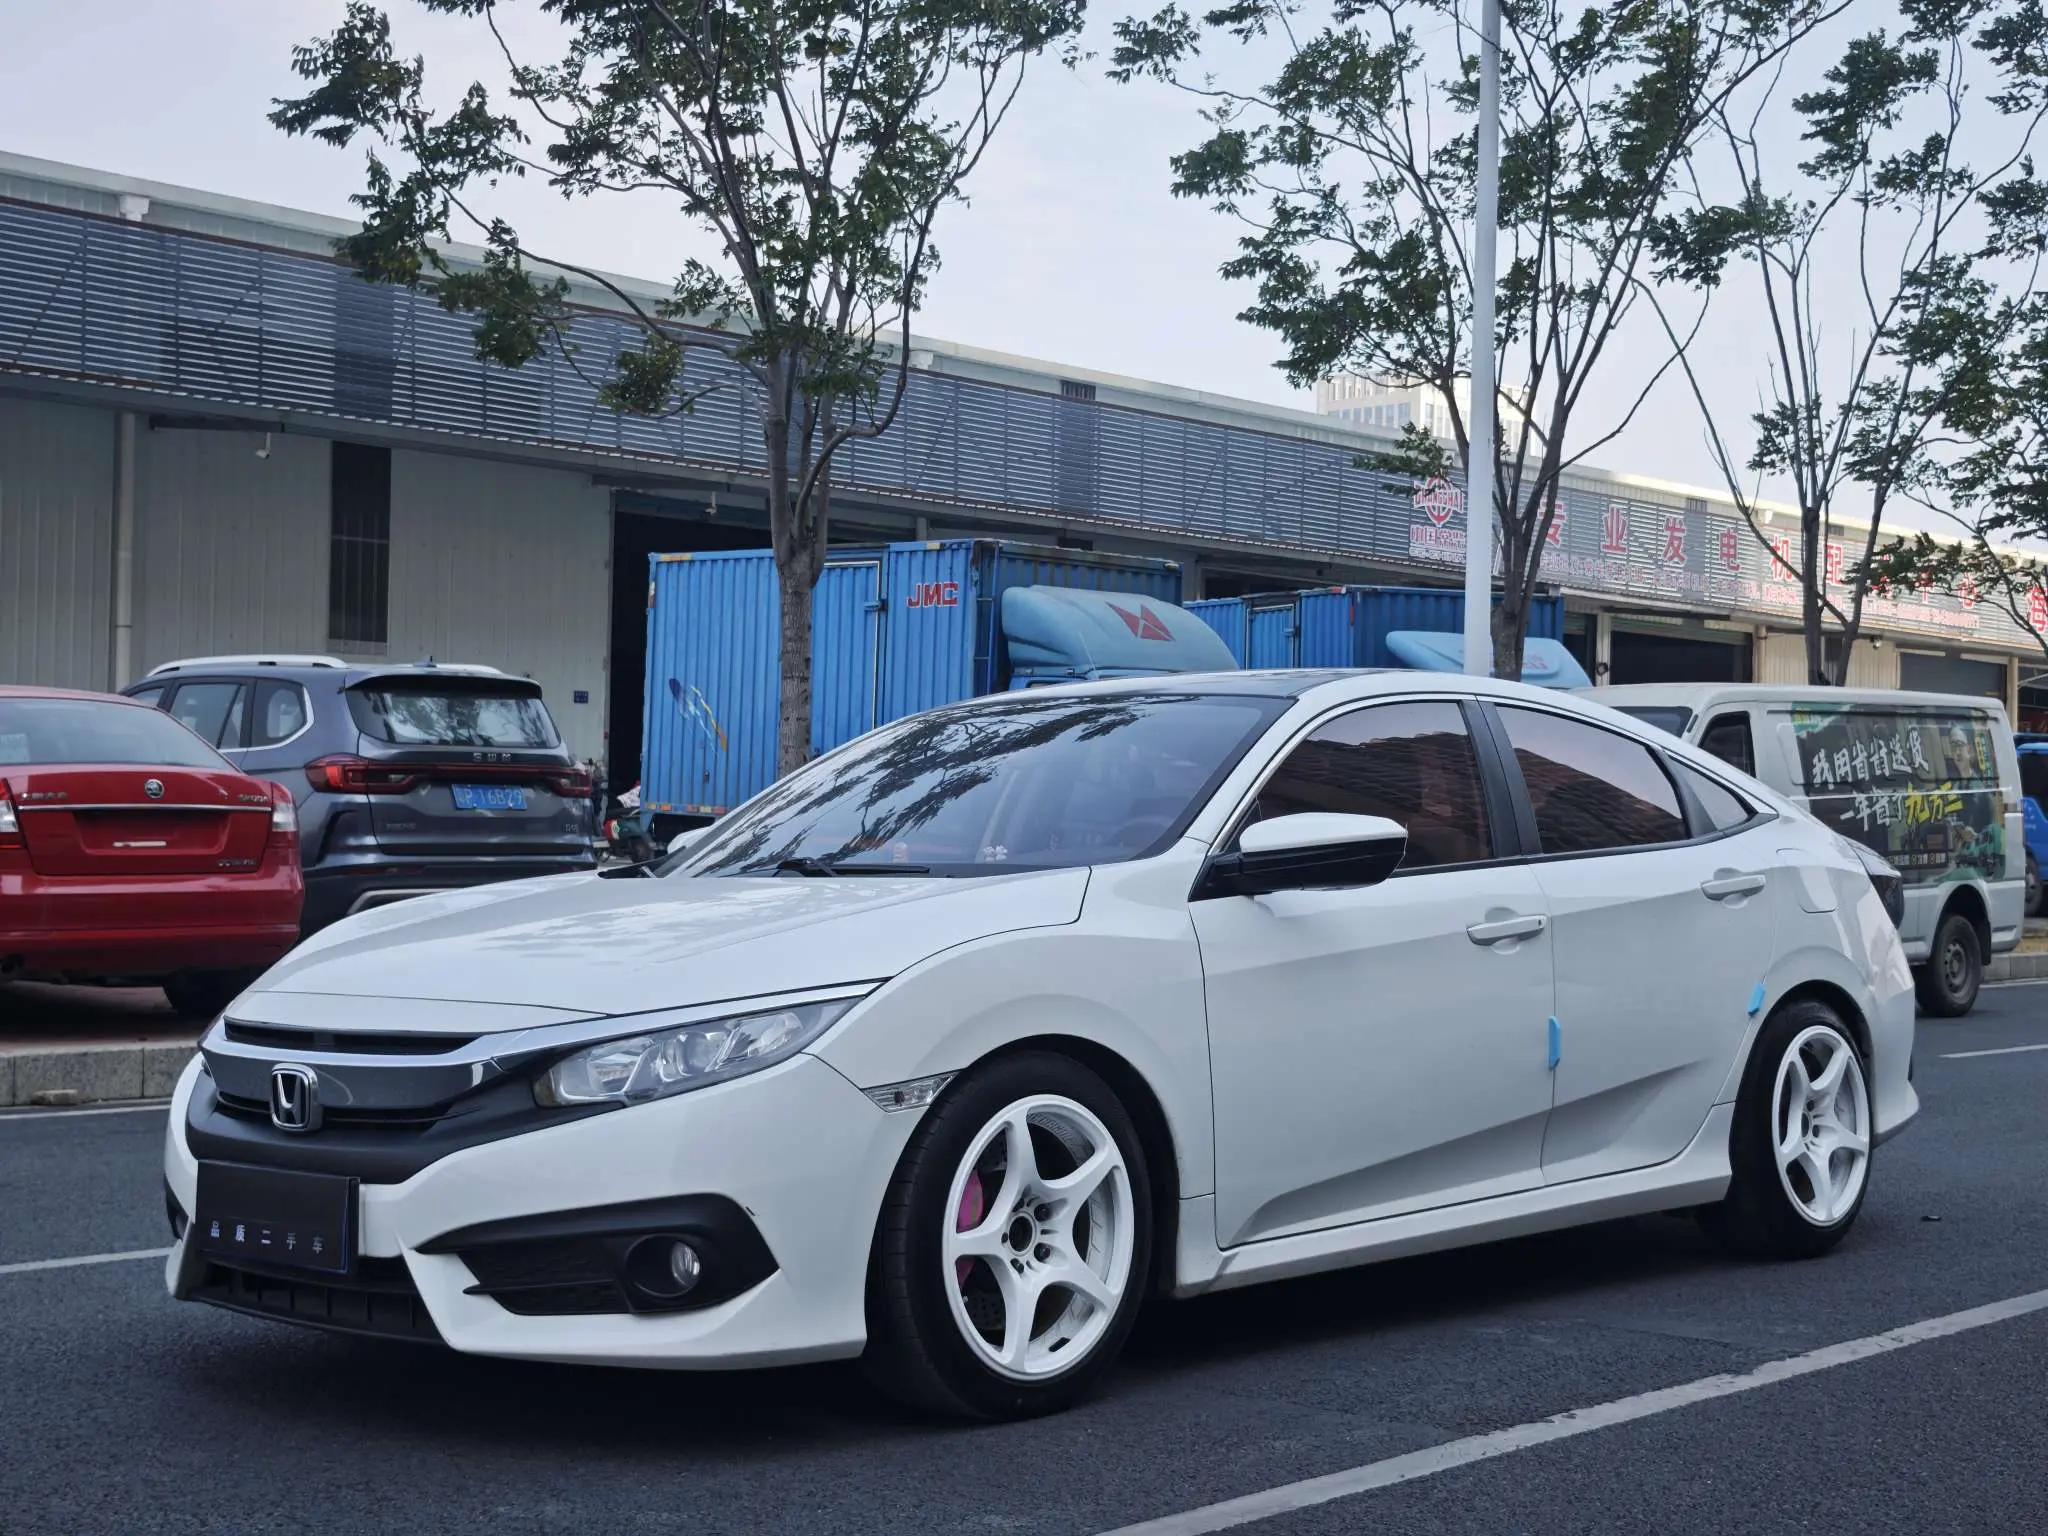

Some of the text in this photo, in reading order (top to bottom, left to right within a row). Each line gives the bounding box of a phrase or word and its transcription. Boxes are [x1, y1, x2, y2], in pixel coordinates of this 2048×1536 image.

[907, 582, 959, 608] JMC
[210, 1220, 323, 1254] 品质二手车
